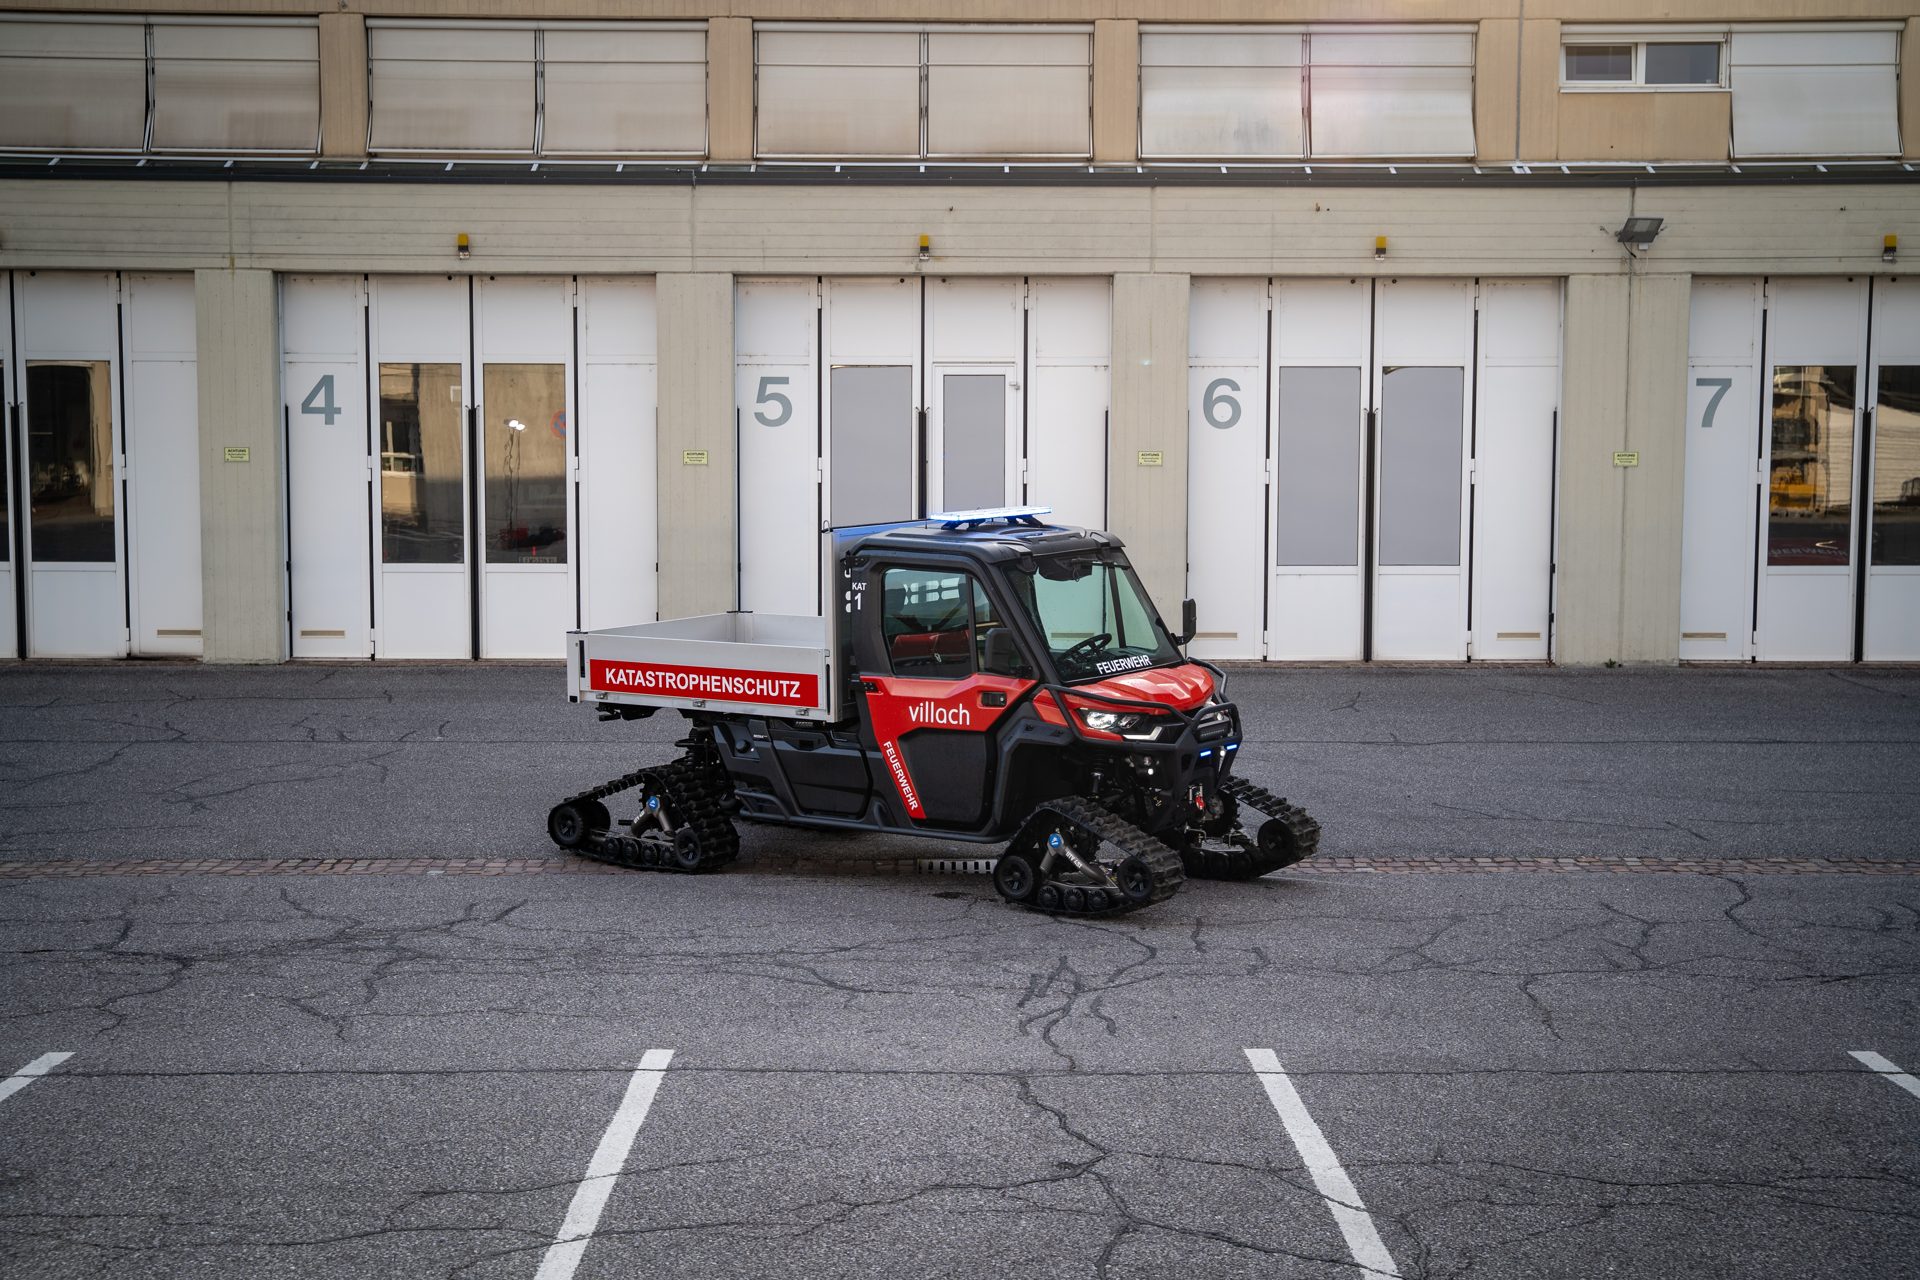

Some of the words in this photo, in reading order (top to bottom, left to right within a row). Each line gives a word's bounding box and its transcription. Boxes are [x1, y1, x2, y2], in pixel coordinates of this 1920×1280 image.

[301, 374, 342, 426] 4
[754, 376, 792, 428] 5
[1203, 378, 1242, 430] 6
[1696, 378, 1733, 428] 7
[852, 582, 867, 591] KAT
[854, 592, 862, 610] 1
[605, 667, 801, 698] KATASTROPHENSCHUTZ
[1096, 654, 1153, 675] FEUERWEHR
[909, 701, 970, 726] villach
[883, 741, 919, 810] FEUERWEHR
